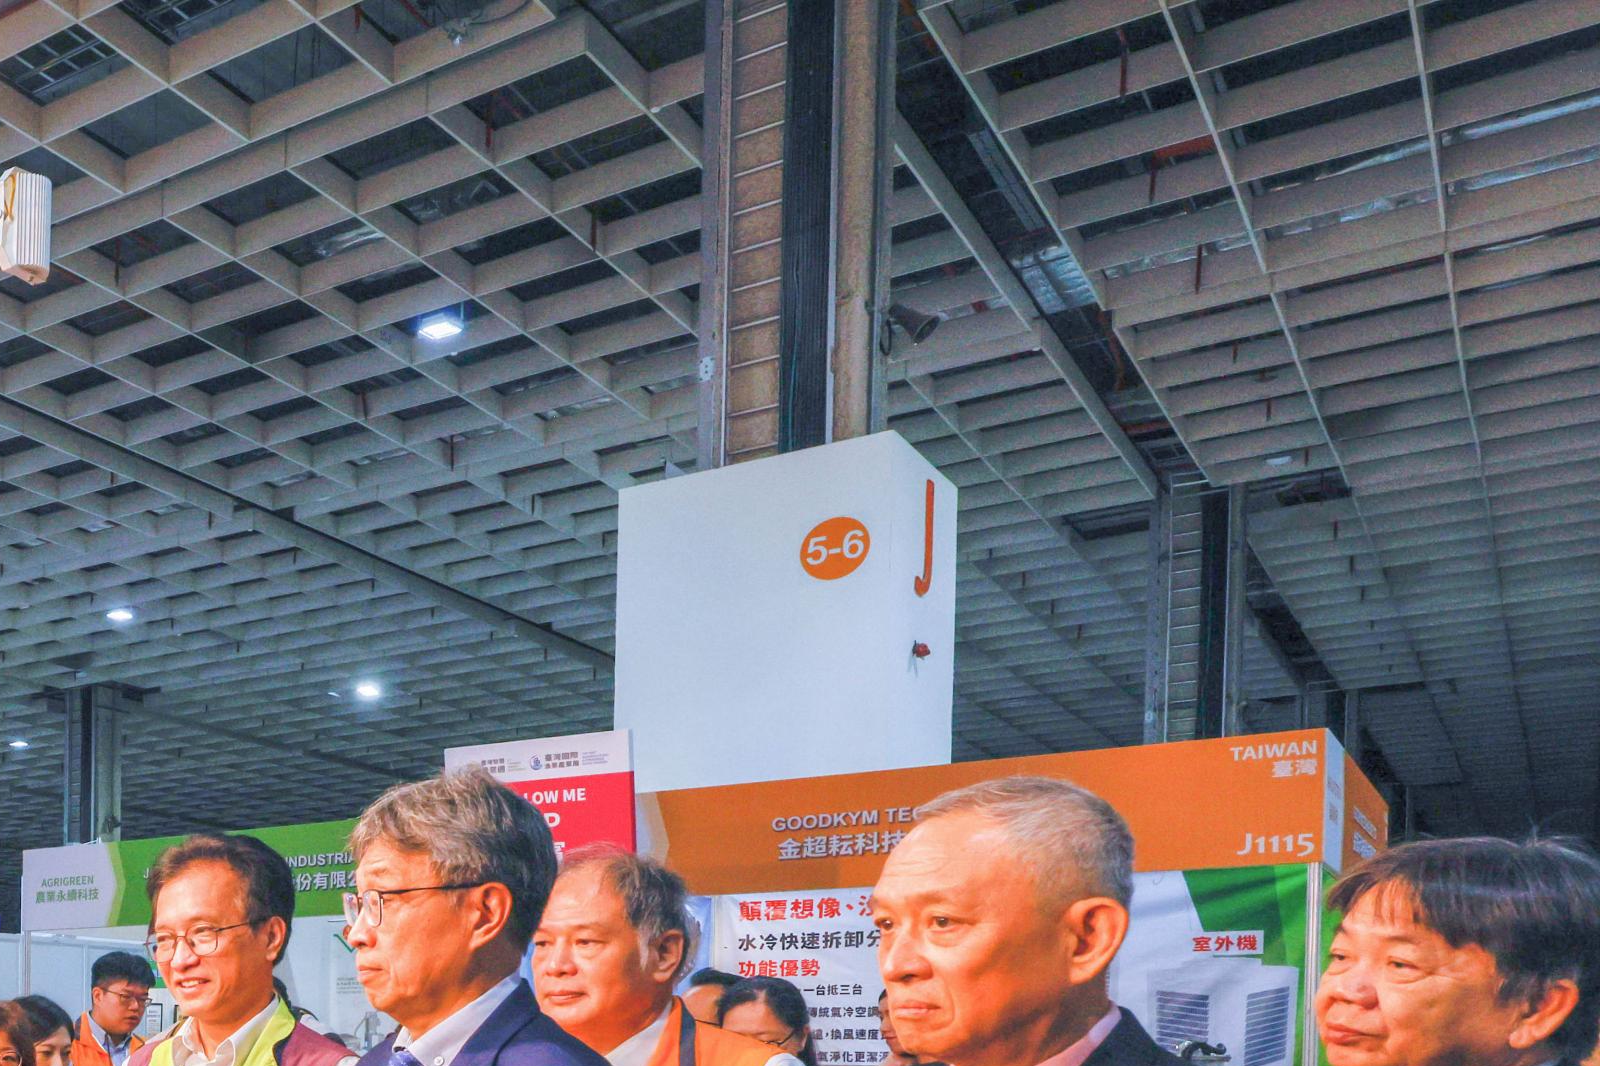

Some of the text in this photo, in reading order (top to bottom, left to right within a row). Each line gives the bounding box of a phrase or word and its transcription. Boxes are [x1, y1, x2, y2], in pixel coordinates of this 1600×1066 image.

[806, 478, 934, 597] 5-6 J
[1230, 740, 1318, 761] TAIWAN
[1271, 759, 1318, 778] 臺灣
[562, 787, 587, 802] ME
[771, 809, 879, 832] GOODKYM
[1236, 832, 1315, 857] J1115
[41, 875, 94, 888] AGRIGREEN
[35, 888, 99, 904] 農業永續科技
[1192, 934, 1258, 952] 室外機
[738, 958, 821, 978] 功能優勢
